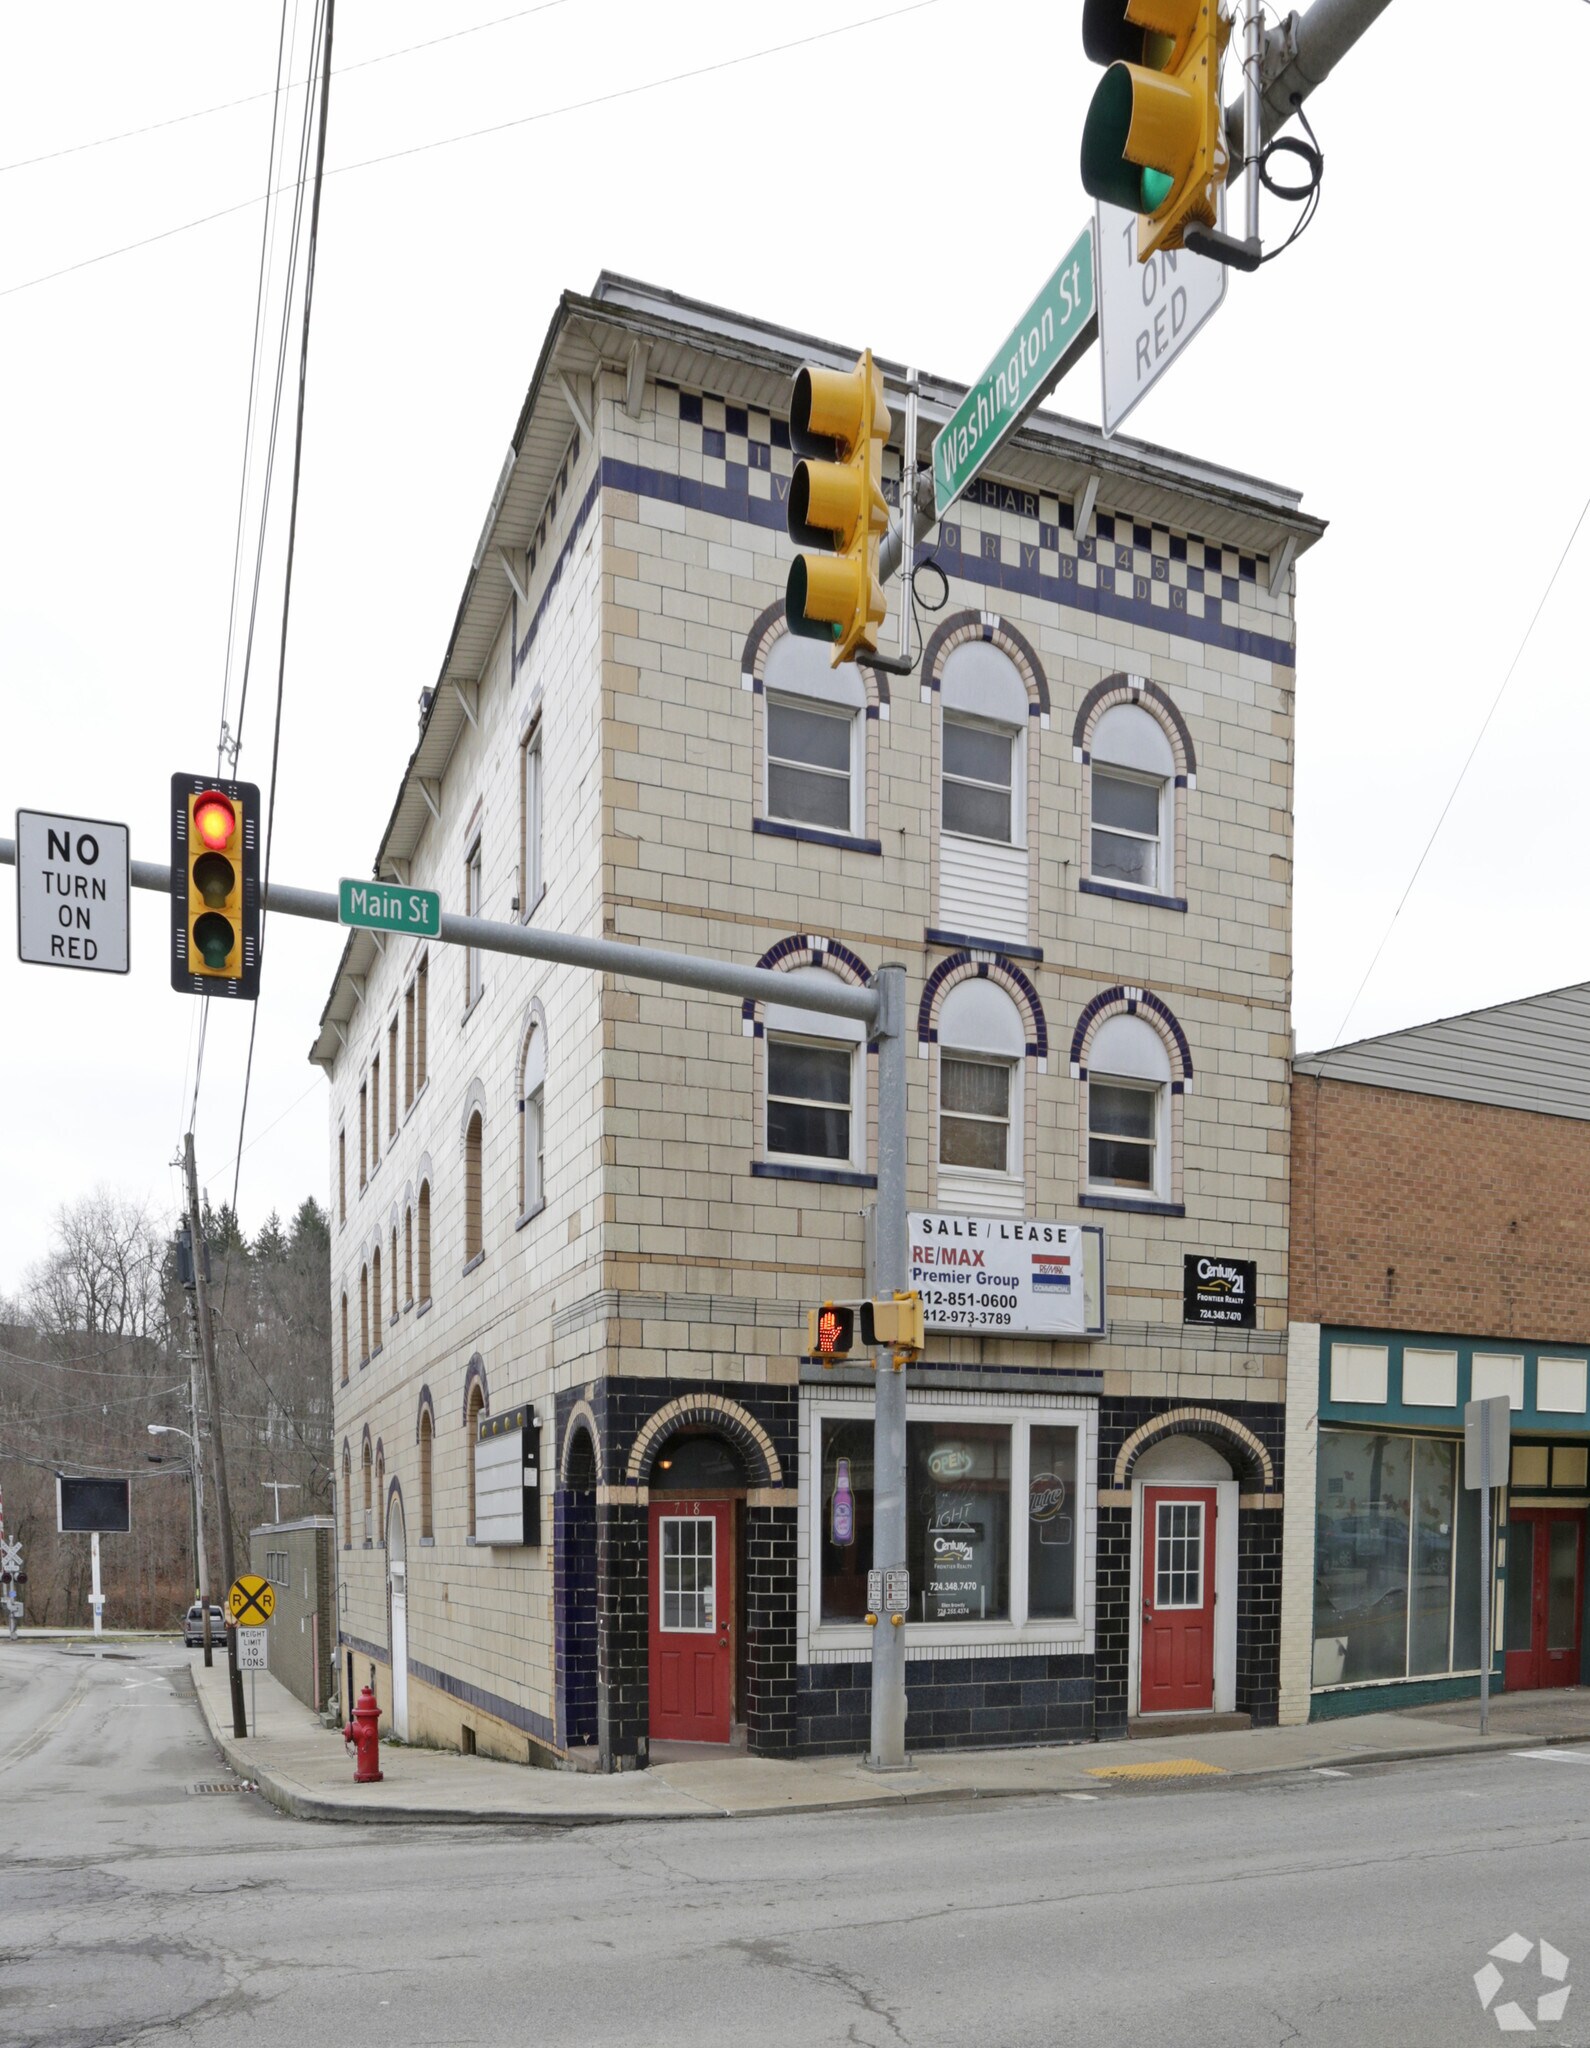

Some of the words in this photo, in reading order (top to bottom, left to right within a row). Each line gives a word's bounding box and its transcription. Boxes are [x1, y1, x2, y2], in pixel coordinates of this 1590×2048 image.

[1136, 285, 1188, 381] RED
[943, 307, 1054, 482] Washington
[1060, 260, 1081, 325] St
[1046, 528, 1166, 579] 1945
[1062, 559, 1184, 610] BLDG
[48, 828, 100, 866] NO
[42, 871, 106, 901] TURN
[58, 904, 91, 930] ON
[351, 887, 402, 920] Main
[408, 895, 429, 924] St
[51, 934, 98, 961] RED
[922, 1218, 978, 1237] SALE
[1000, 1224, 1068, 1244] LEASE
[912, 1245, 986, 1267] RE/MAX
[912, 1267, 972, 1284] Premier
[975, 1271, 1020, 1290] Group
[1197, 1258, 1237, 1282] Century
[1231, 1274, 1244, 1294] 21
[1196, 1292, 1225, 1303] FRONTIER
[1225, 1295, 1244, 1304] REALTY
[1199, 1309, 1242, 1321] 724.348.7470
[931, 1450, 966, 1473] OPEN
[674, 1501, 701, 1515] 718
[927, 1502, 973, 1533] LIGHT
[933, 1537, 968, 1553] Century
[963, 1546, 973, 1561] 21
[929, 1582, 977, 1591] 724.348.7470
[232, 1594, 242, 1607] R
[262, 1595, 272, 1607] R
[240, 1630, 266, 1638] WEIGHT
[242, 1658, 265, 1667] TONS
[247, 1648, 259, 1656] 10
